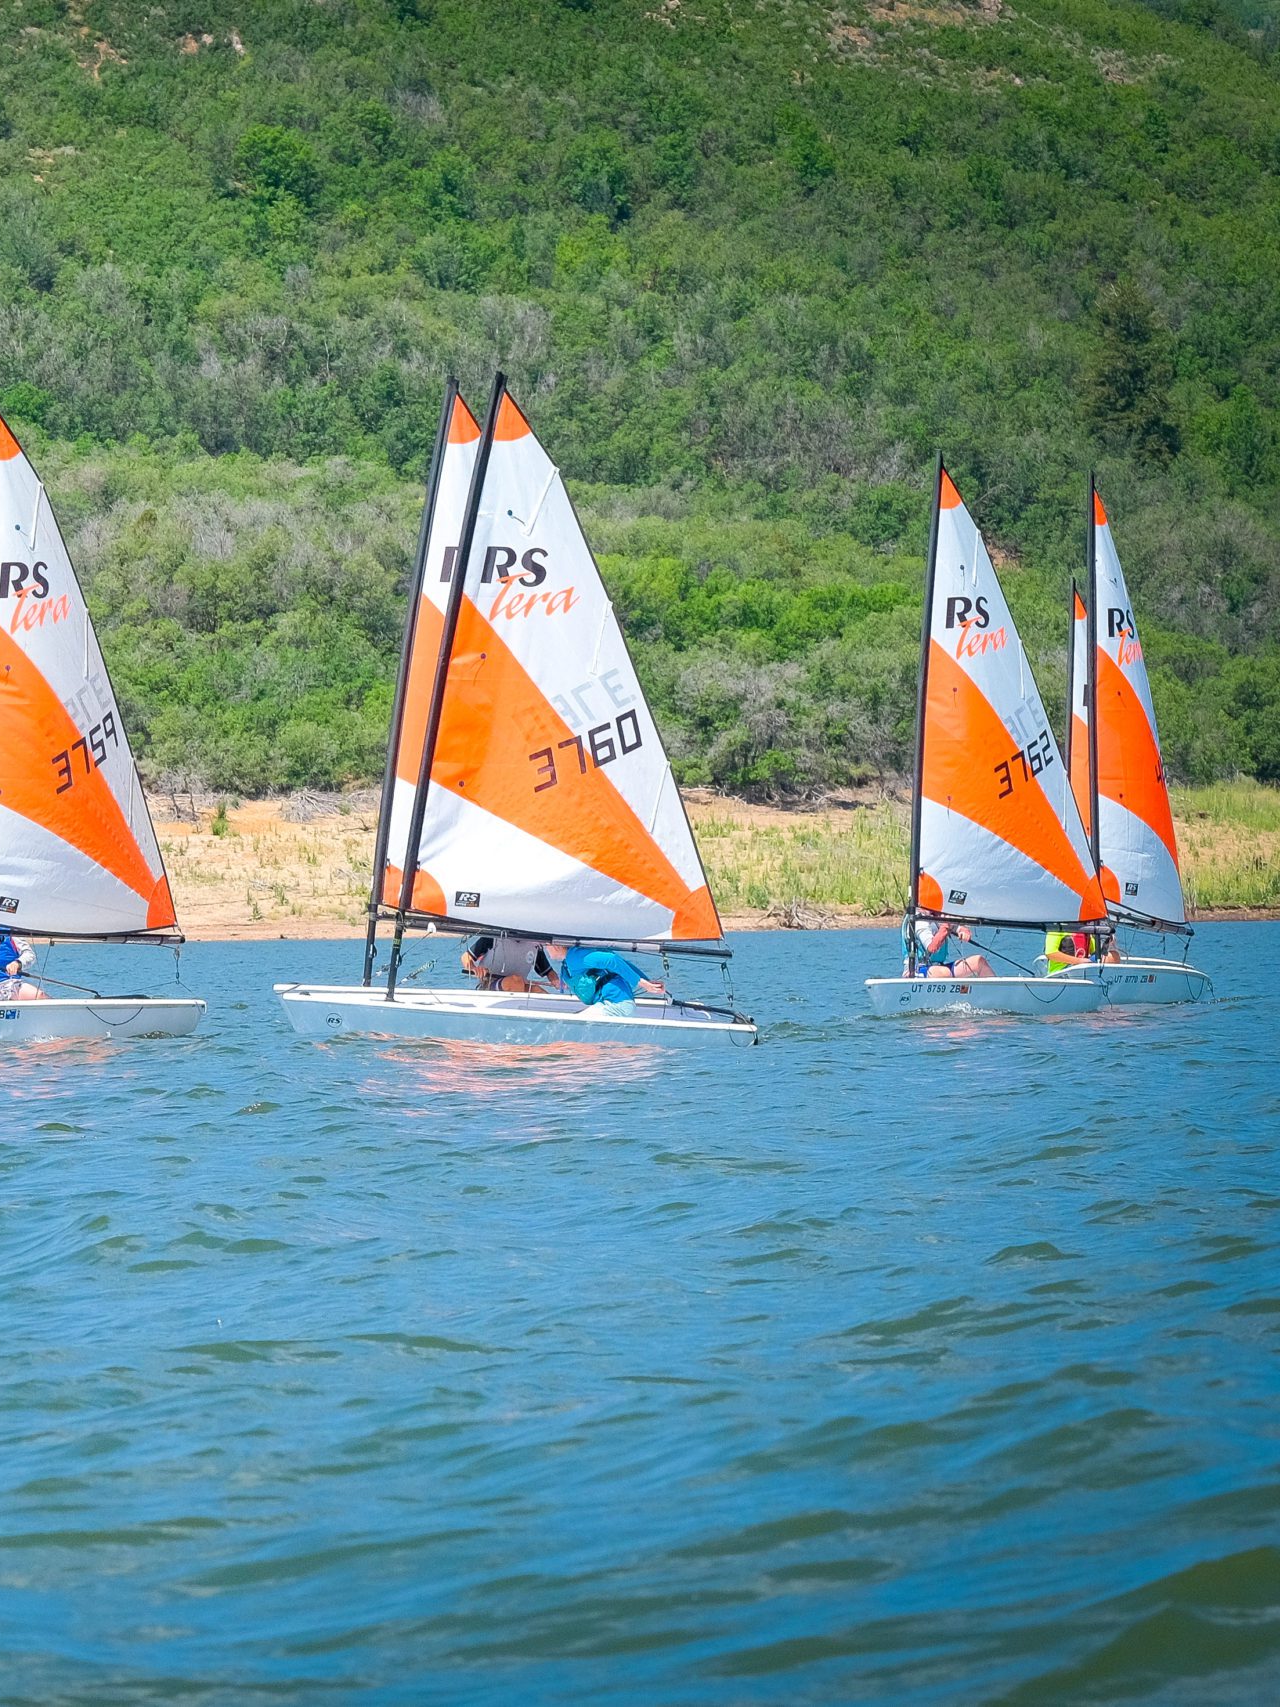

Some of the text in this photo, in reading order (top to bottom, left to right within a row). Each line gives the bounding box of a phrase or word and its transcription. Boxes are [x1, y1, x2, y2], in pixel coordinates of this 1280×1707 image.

[481, 546, 549, 587] RS
[10, 584, 71, 635] Tera
[489, 572, 581, 621] Tera
[945, 596, 990, 630] RS
[956, 617, 1008, 660] Tera
[1107, 608, 1135, 639] RS
[52, 711, 118, 795] 3759
[529, 708, 643, 793] 3760
[994, 729, 1054, 799] 3762
[2, 898, 18, 908] RS
[459, 893, 479, 902] RS
[911, 985, 923, 993] UT
[927, 985, 946, 993] 8759
